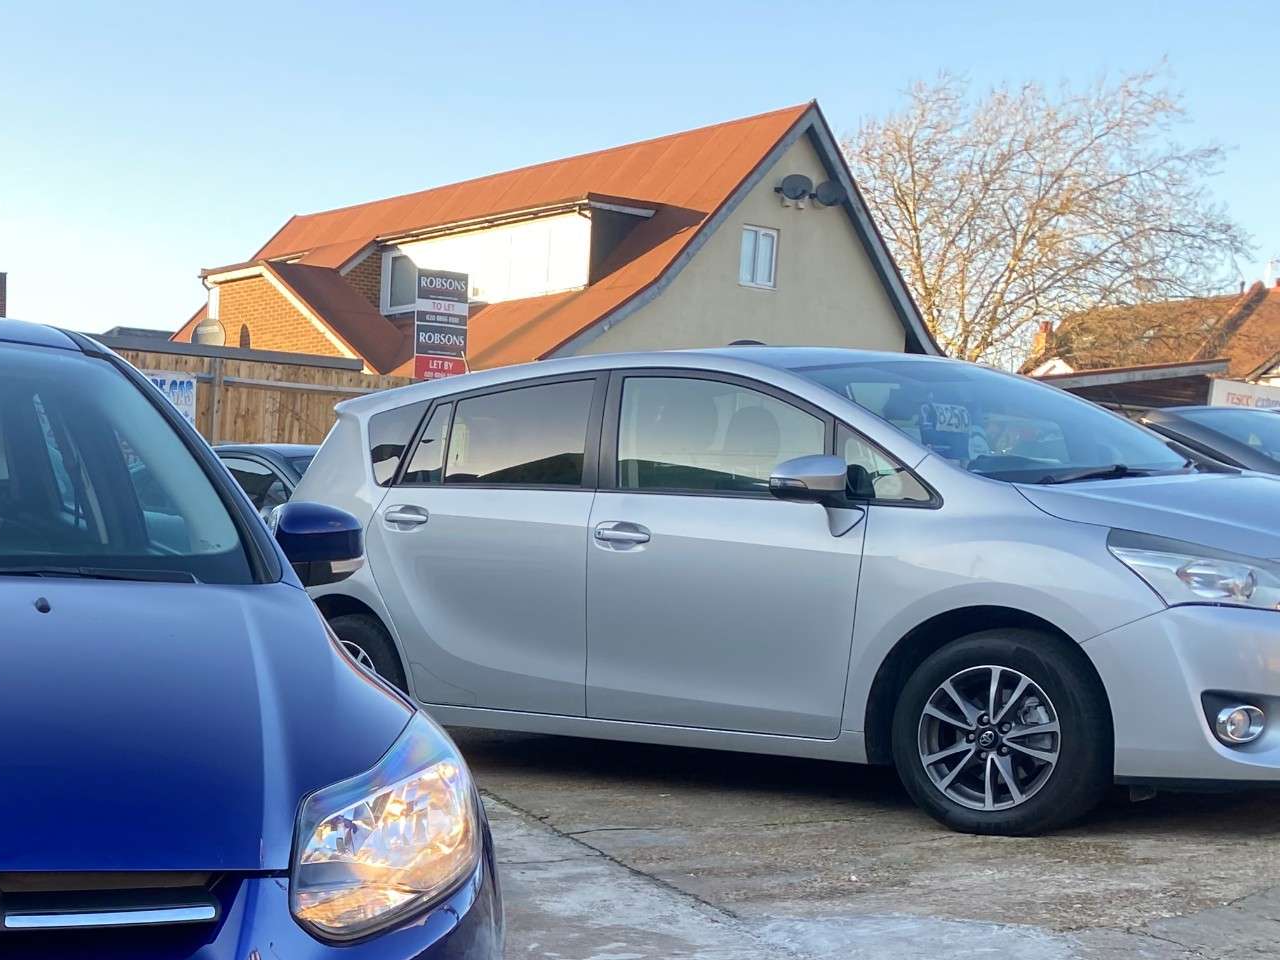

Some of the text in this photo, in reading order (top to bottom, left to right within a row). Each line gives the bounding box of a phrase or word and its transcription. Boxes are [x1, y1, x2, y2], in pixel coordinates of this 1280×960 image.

[420, 276, 466, 291] ROBSONS
[431, 301, 442, 311] TO
[419, 331, 465, 346] ROBSONS
[429, 360, 454, 370] LET BY
